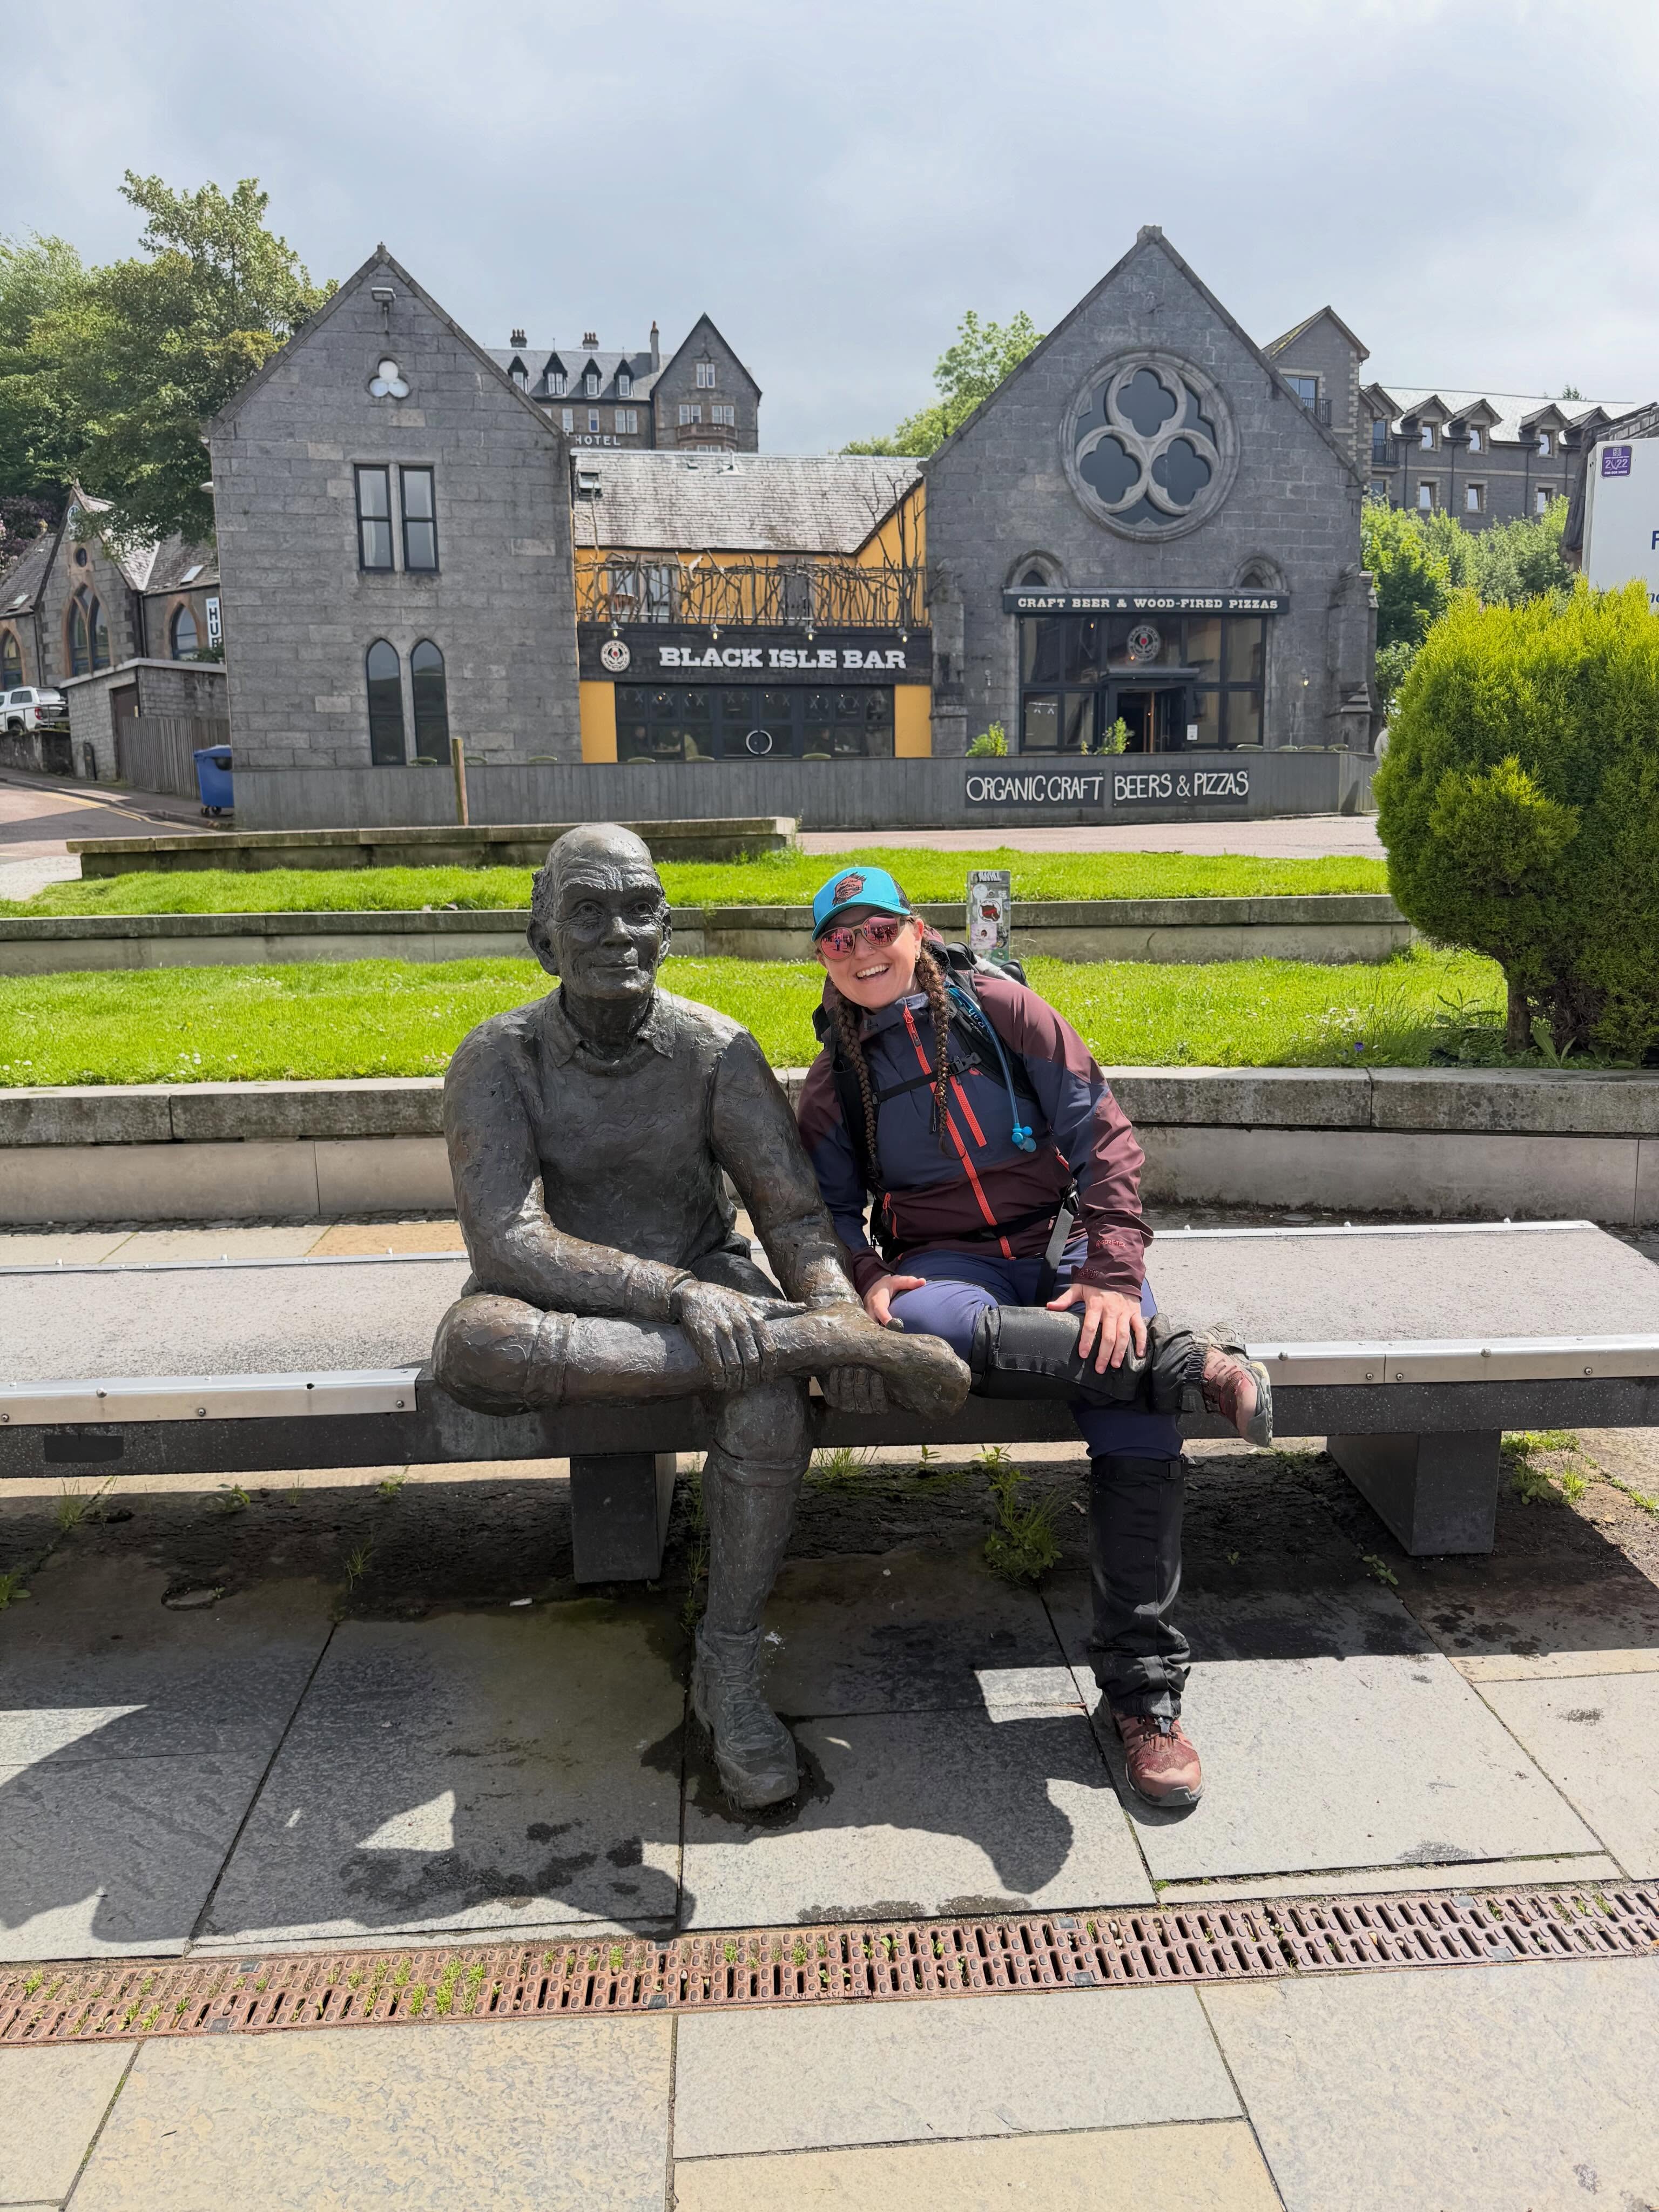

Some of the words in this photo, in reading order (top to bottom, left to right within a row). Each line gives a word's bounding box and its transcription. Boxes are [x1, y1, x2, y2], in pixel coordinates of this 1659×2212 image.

[575, 434, 621, 446] HOTEL
[1018, 598, 1065, 608] CRAFT
[1072, 598, 1110, 608] BEER
[1116, 598, 1127, 608] &
[1134, 598, 1223, 609] WOOD-FIRED
[1229, 599, 1278, 609] PIZZAS
[659, 647, 763, 668] BLACK
[768, 649, 837, 669] ISLE
[842, 650, 906, 669] BAR
[966, 775, 1046, 801] ORGANIC
[1047, 776, 1104, 801] CRAFT
[1114, 773, 1172, 800] BEERS
[1176, 775, 1191, 797] &
[1194, 771, 1249, 796] PIZZAS
[1101, 1239, 1127, 1248] GORE-TEX
